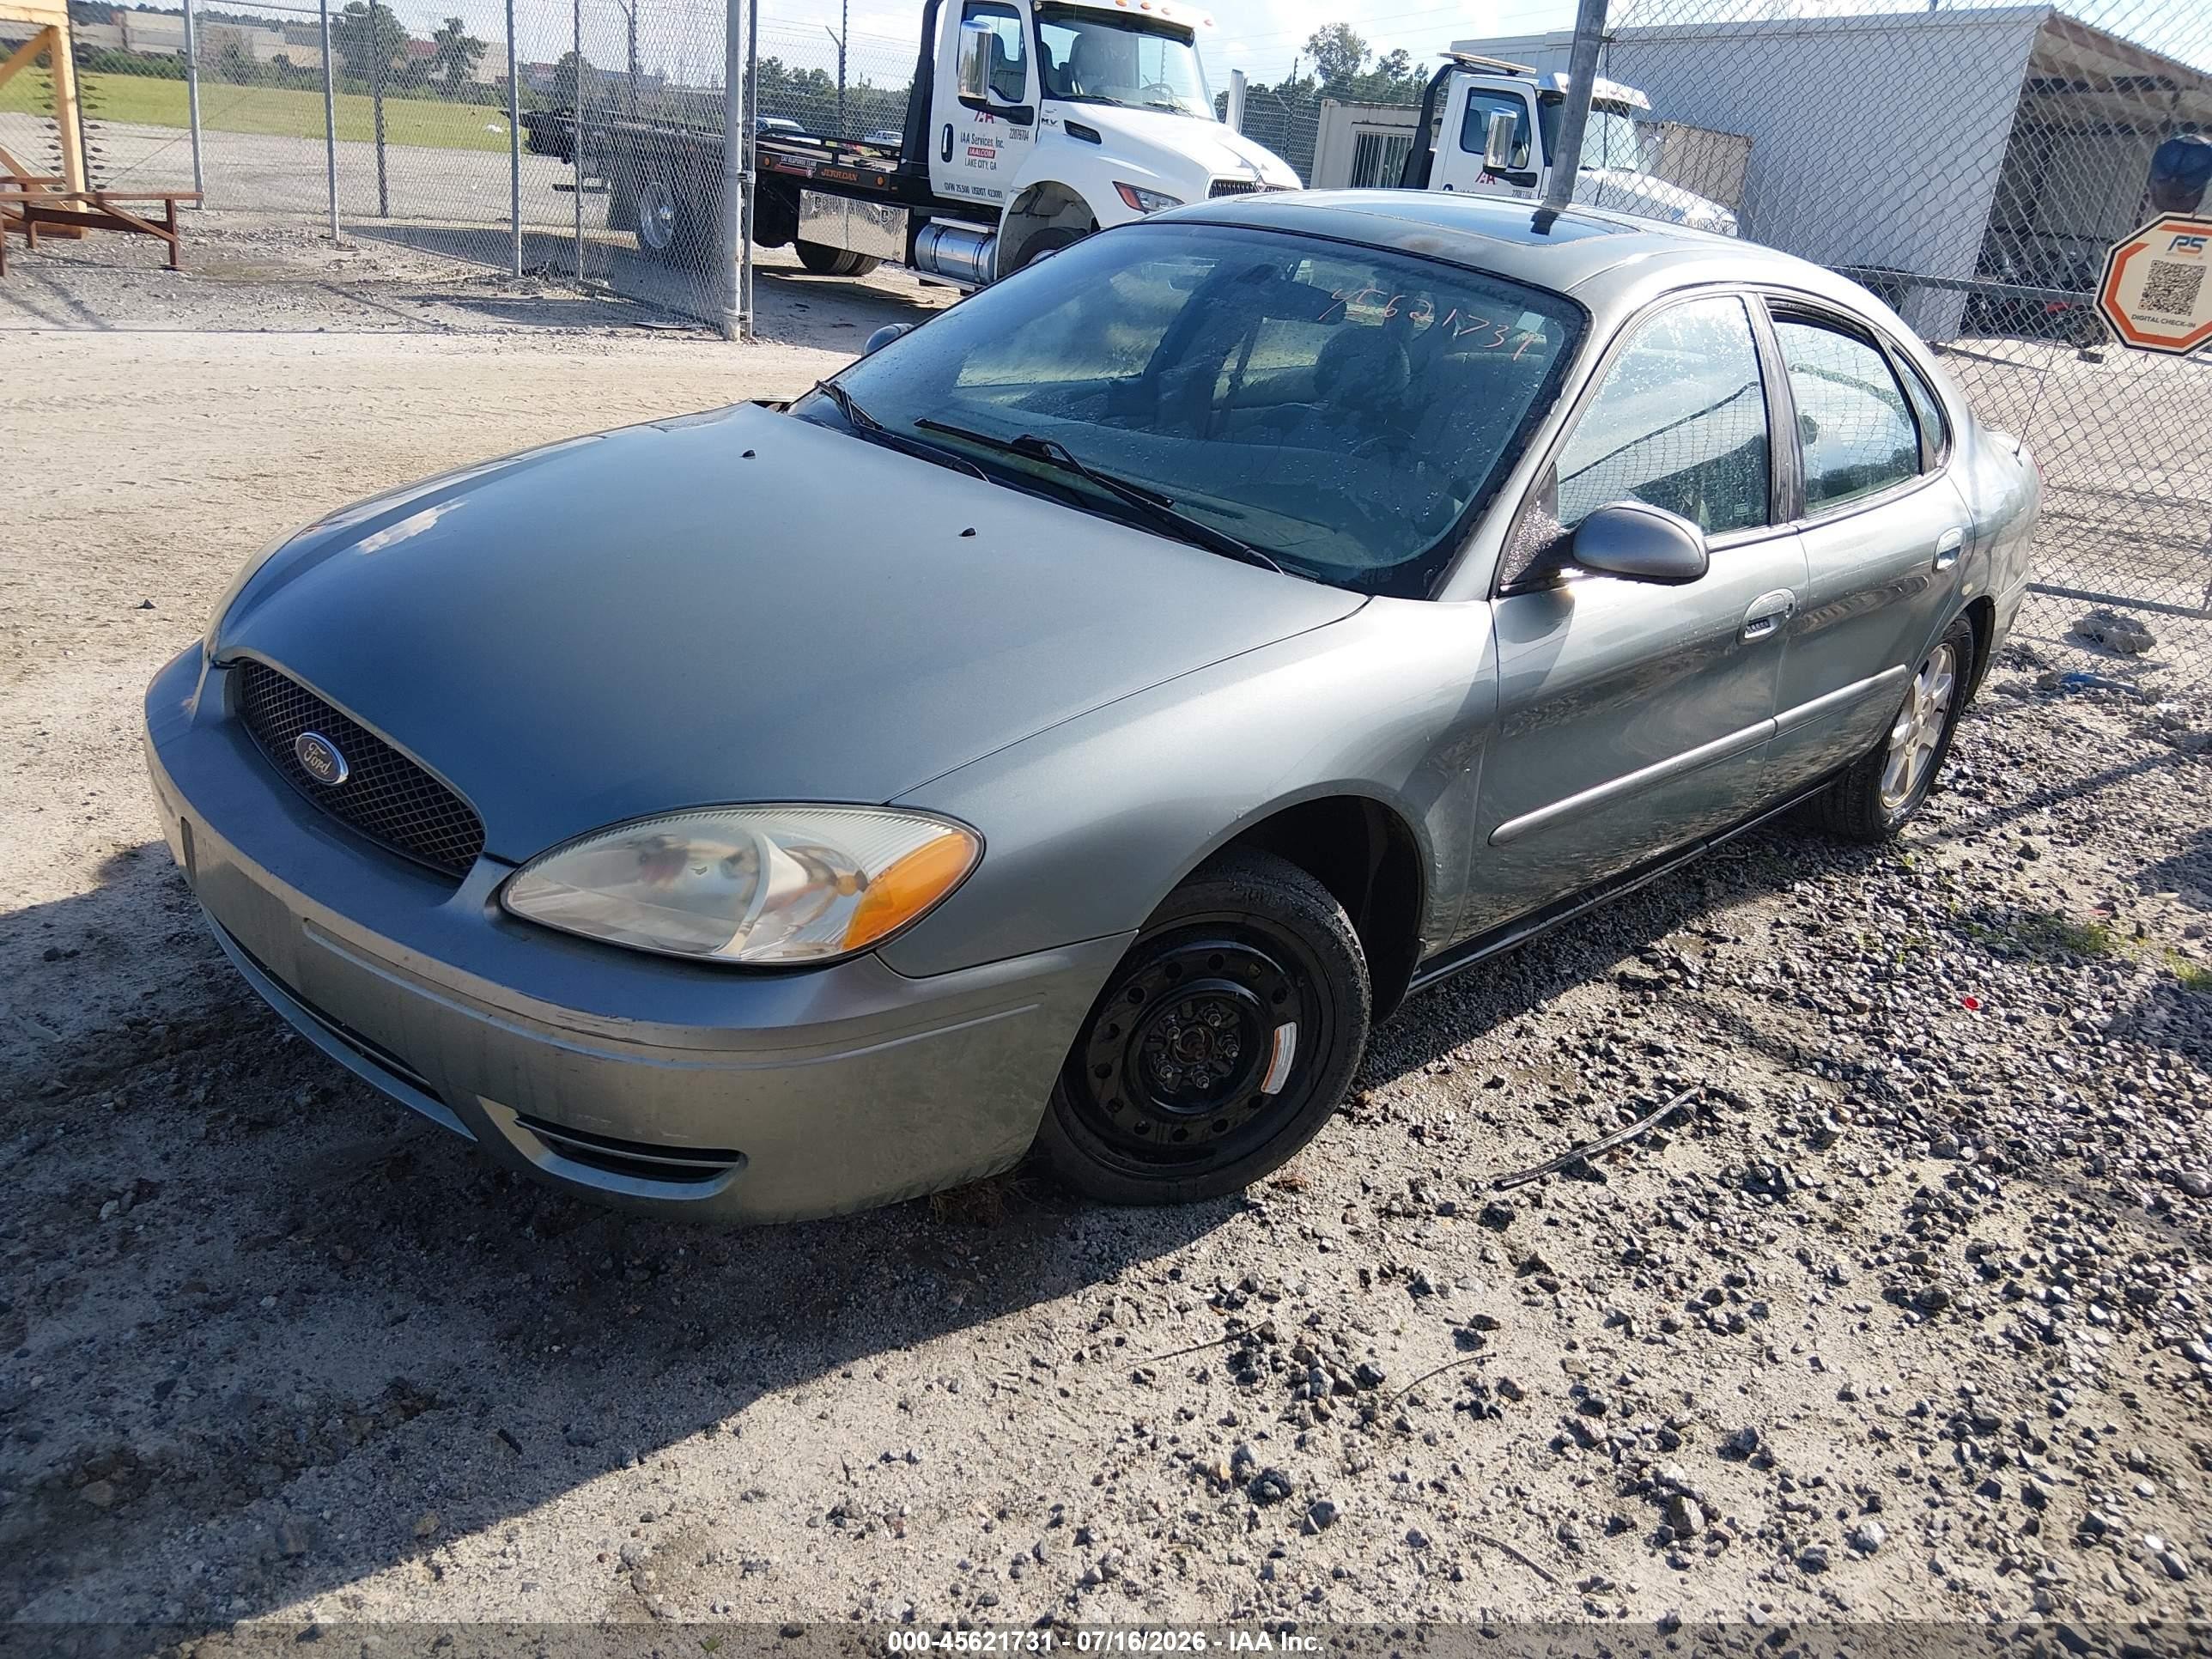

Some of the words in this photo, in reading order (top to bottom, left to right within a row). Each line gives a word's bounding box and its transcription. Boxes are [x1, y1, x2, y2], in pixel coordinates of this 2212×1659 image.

[960, 131, 969, 144] IAA
[964, 158, 977, 168] LAKE
[989, 161, 996, 171] GA
[2131, 313, 2160, 323] DIGITAL
[2160, 318, 2197, 328] CHECK-IN
[304, 742, 333, 775] Ford
